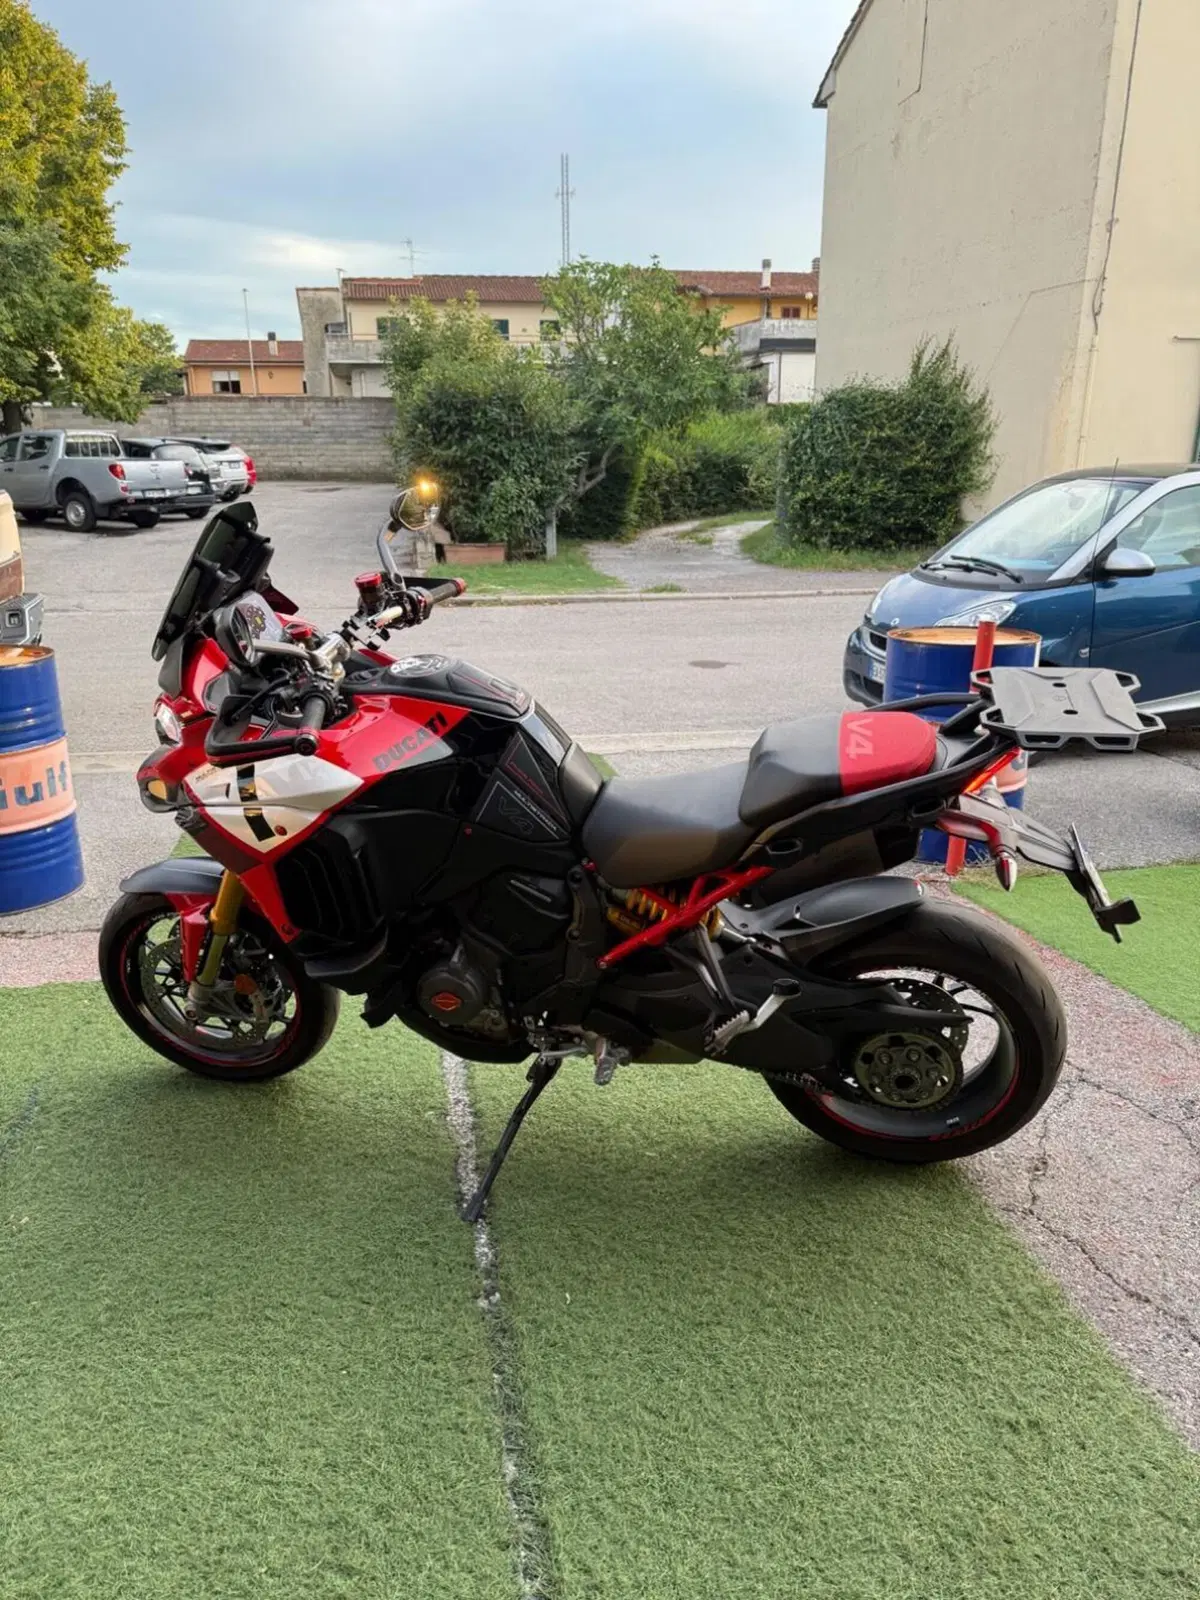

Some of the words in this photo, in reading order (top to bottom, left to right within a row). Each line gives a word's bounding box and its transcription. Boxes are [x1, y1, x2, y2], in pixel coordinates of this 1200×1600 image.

[372, 709, 448, 772] DUCATI
[845, 718, 873, 760] V4
[0, 760, 67, 811] ulf
